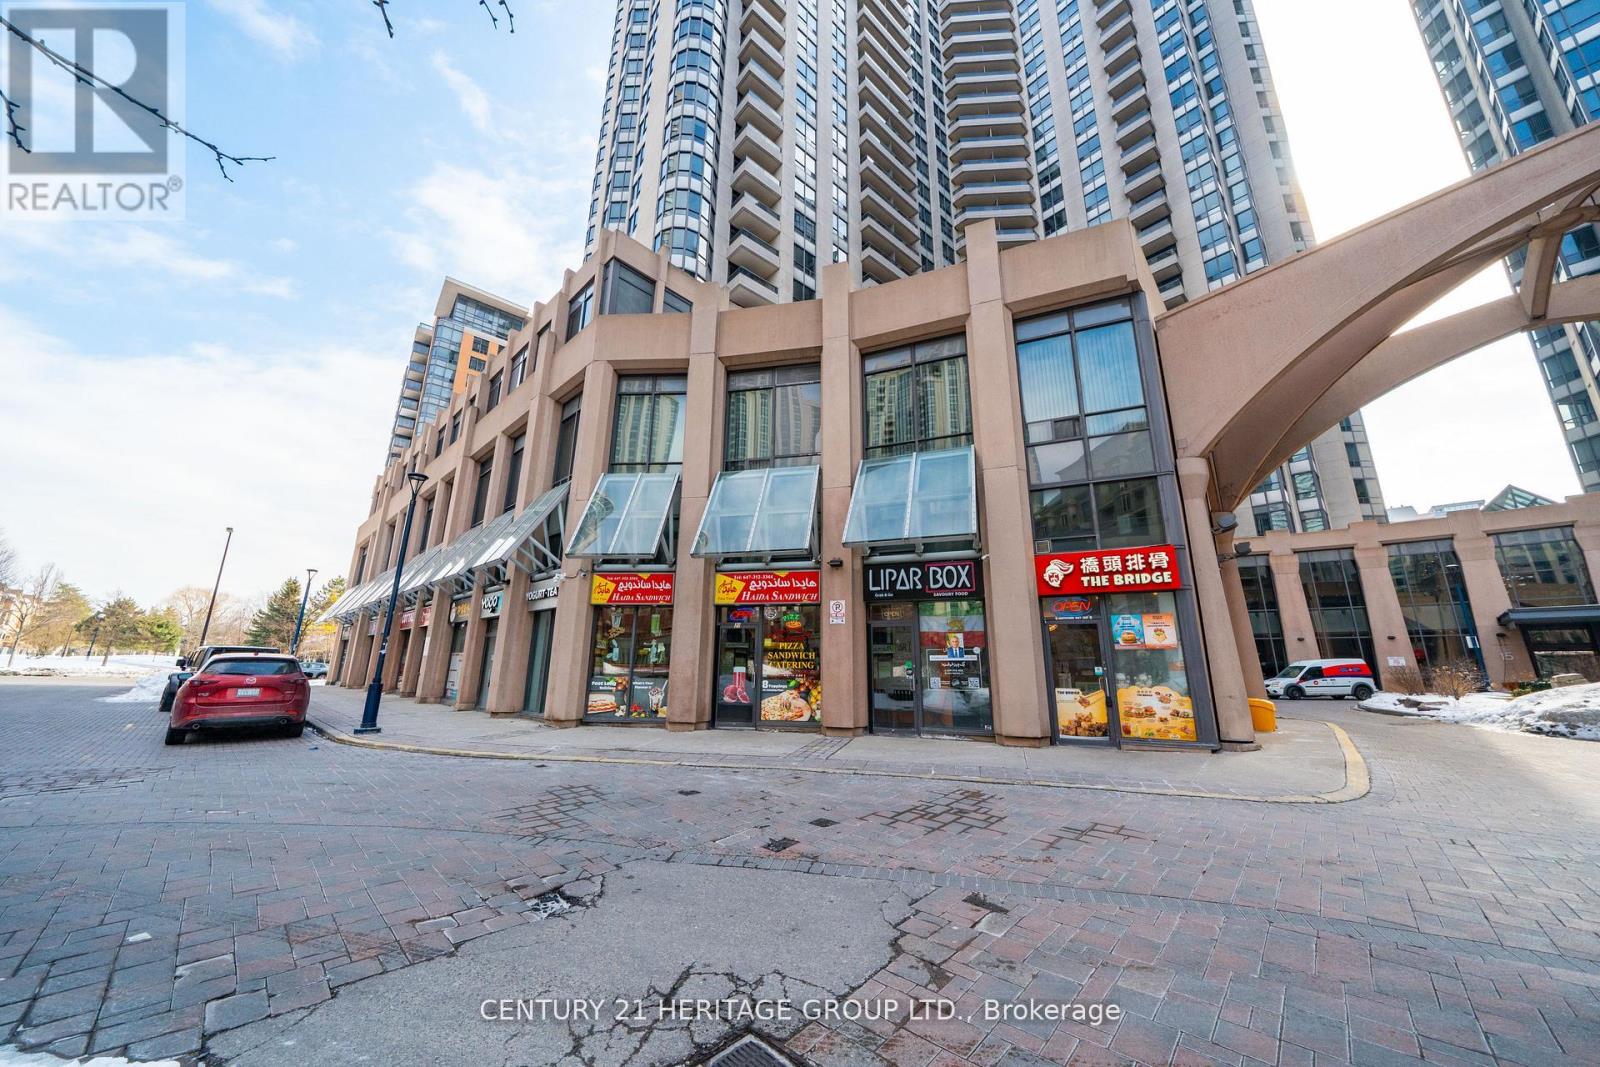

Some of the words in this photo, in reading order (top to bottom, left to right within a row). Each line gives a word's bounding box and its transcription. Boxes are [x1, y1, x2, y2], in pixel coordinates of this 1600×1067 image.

[1080, 552, 1169, 574] 橋頭排骨
[869, 567, 923, 591] LIPAR
[929, 565, 971, 589] BOX
[1081, 575, 1110, 587] THE
[1113, 571, 1172, 586] BRIDGE
[635, 592, 671, 601] SANDWICH
[742, 591, 770, 600] HAIDA
[772, 590, 818, 600] SANDWICH
[1053, 600, 1092, 612] OPEN
[779, 642, 804, 650] PIZZA
[767, 651, 816, 660] SANDWICH
[768, 661, 815, 669] CATERING
[762, 680, 769, 689] 8
